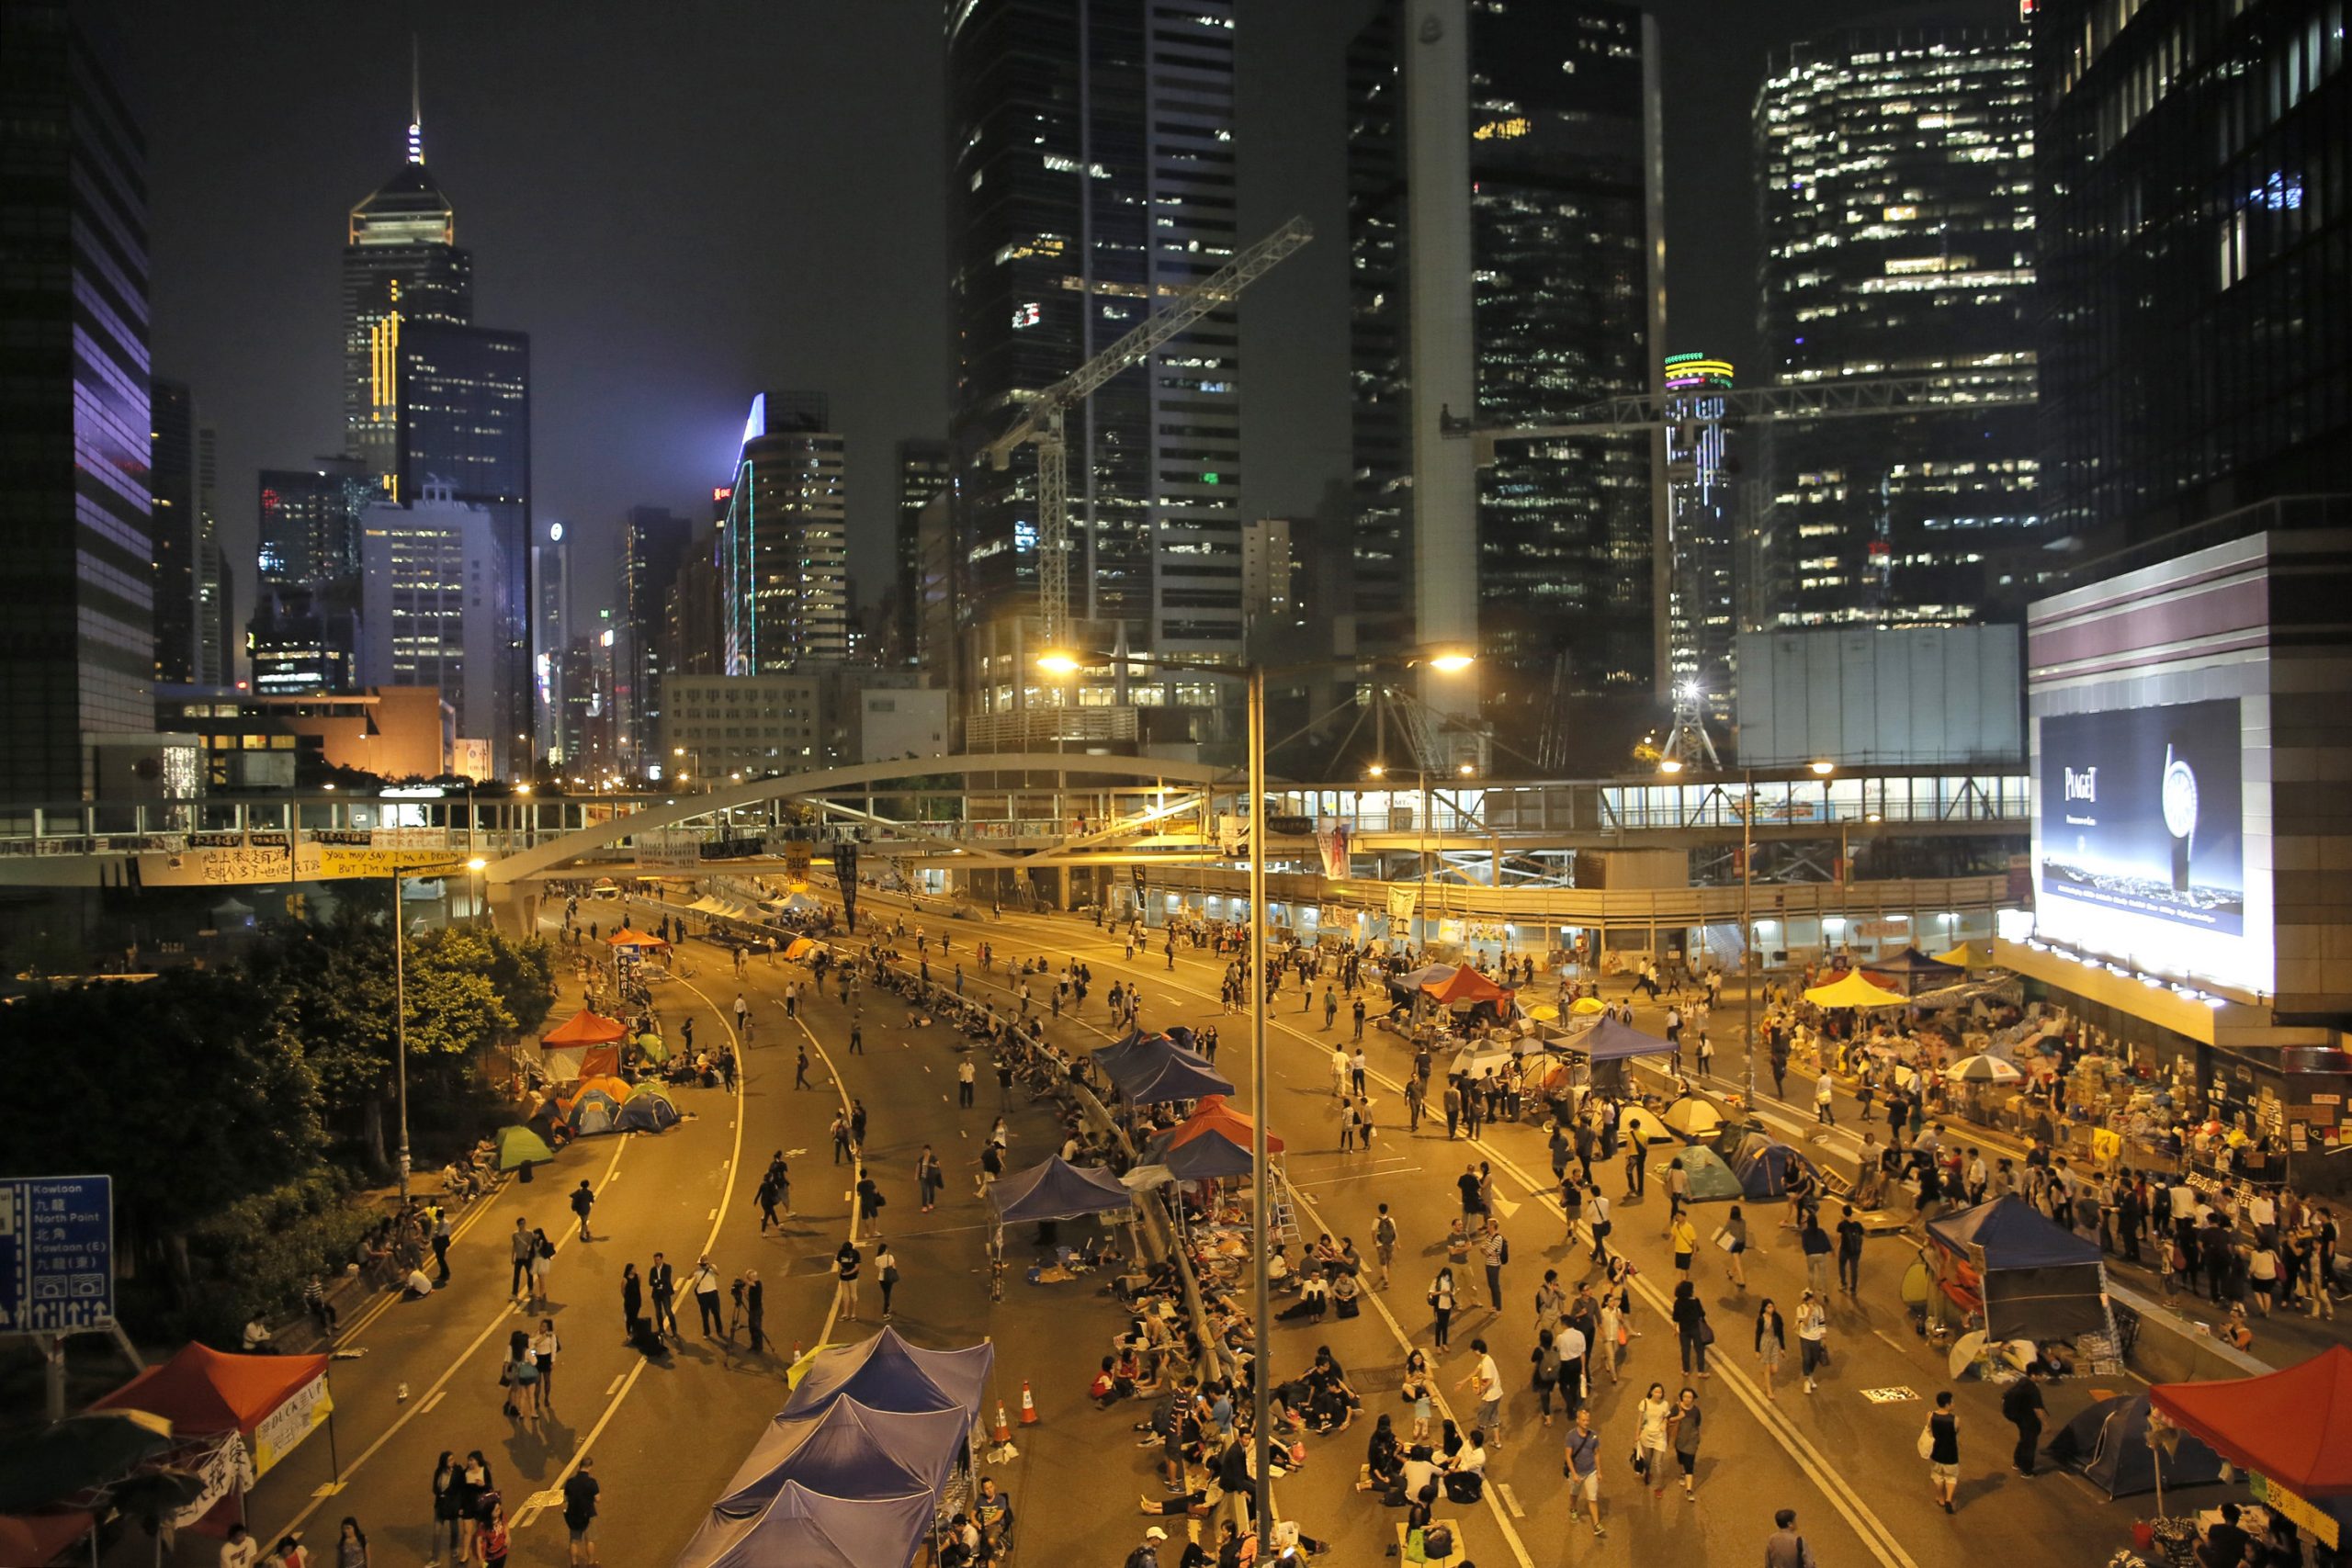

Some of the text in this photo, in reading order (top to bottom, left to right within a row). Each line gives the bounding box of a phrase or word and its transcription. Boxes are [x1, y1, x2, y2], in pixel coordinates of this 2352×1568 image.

[2064, 766, 2098, 803] PIAGET
[33, 1184, 83, 1194] Kowloon
[35, 1199, 65, 1212] 九龍
[34, 1213, 99, 1224] North Point
[35, 1228, 66, 1241] 北角
[34, 1242, 107, 1253] Kowloon (E)
